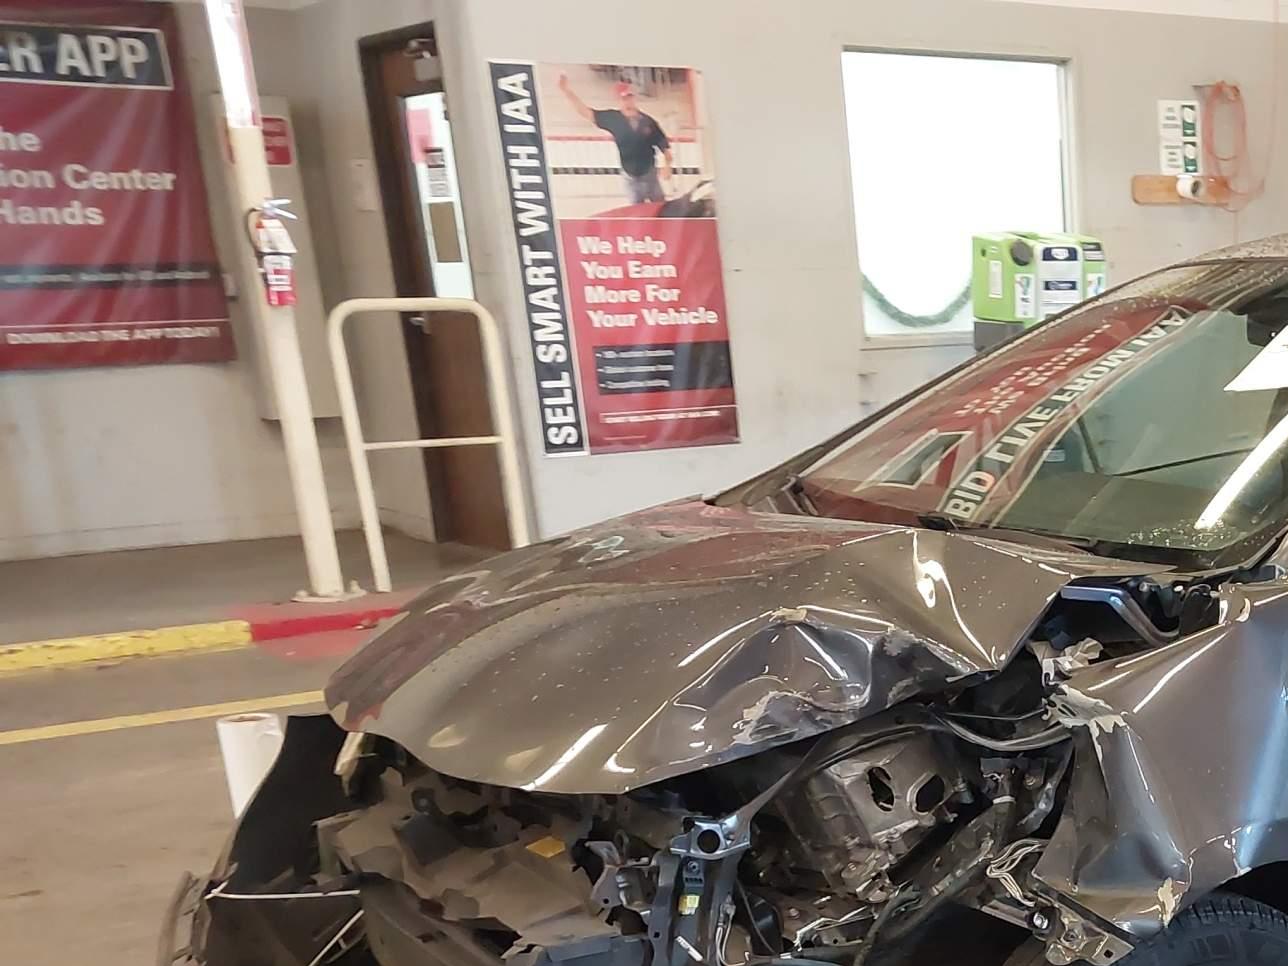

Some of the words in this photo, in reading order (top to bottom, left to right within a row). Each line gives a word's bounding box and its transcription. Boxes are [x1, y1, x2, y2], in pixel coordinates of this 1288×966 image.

[56, 33, 149, 79] APP
[497, 72, 537, 133] IAA
[62, 163, 176, 190] Center
[506, 145, 549, 236] WITH
[576, 236, 613, 254] We
[616, 235, 667, 258] Help
[580, 260, 624, 279] You
[627, 260, 677, 278] Earn
[522, 245, 568, 363] SMART
[584, 285, 641, 303] More
[644, 283, 680, 302] For
[585, 309, 638, 328] Your
[641, 306, 719, 325] Vehicle
[541, 371, 579, 445] SELL
